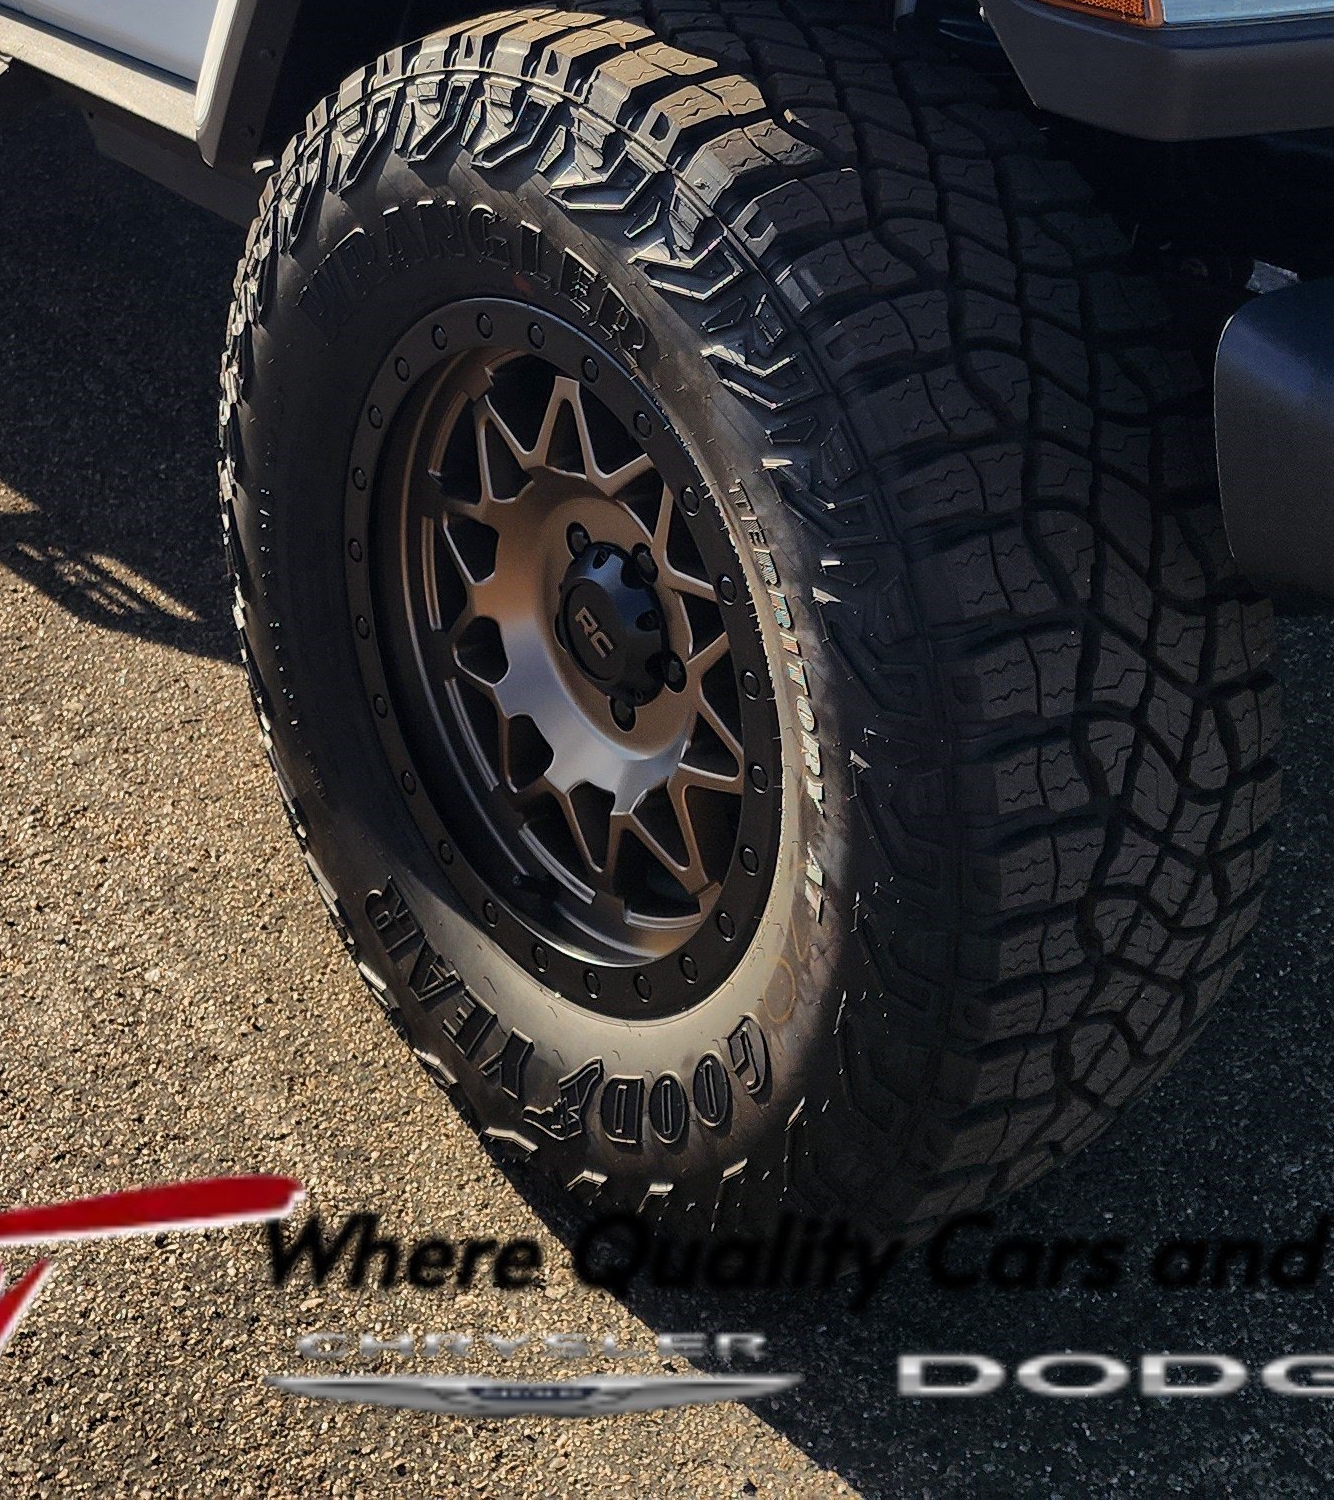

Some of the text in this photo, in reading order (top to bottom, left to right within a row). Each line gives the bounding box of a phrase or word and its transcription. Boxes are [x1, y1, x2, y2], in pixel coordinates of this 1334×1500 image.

[295, 198, 657, 380] WRANGLER
[574, 606, 614, 659] RC
[727, 478, 825, 923] TERRITORY AT
[364, 875, 770, 1145] GOODYEAR
